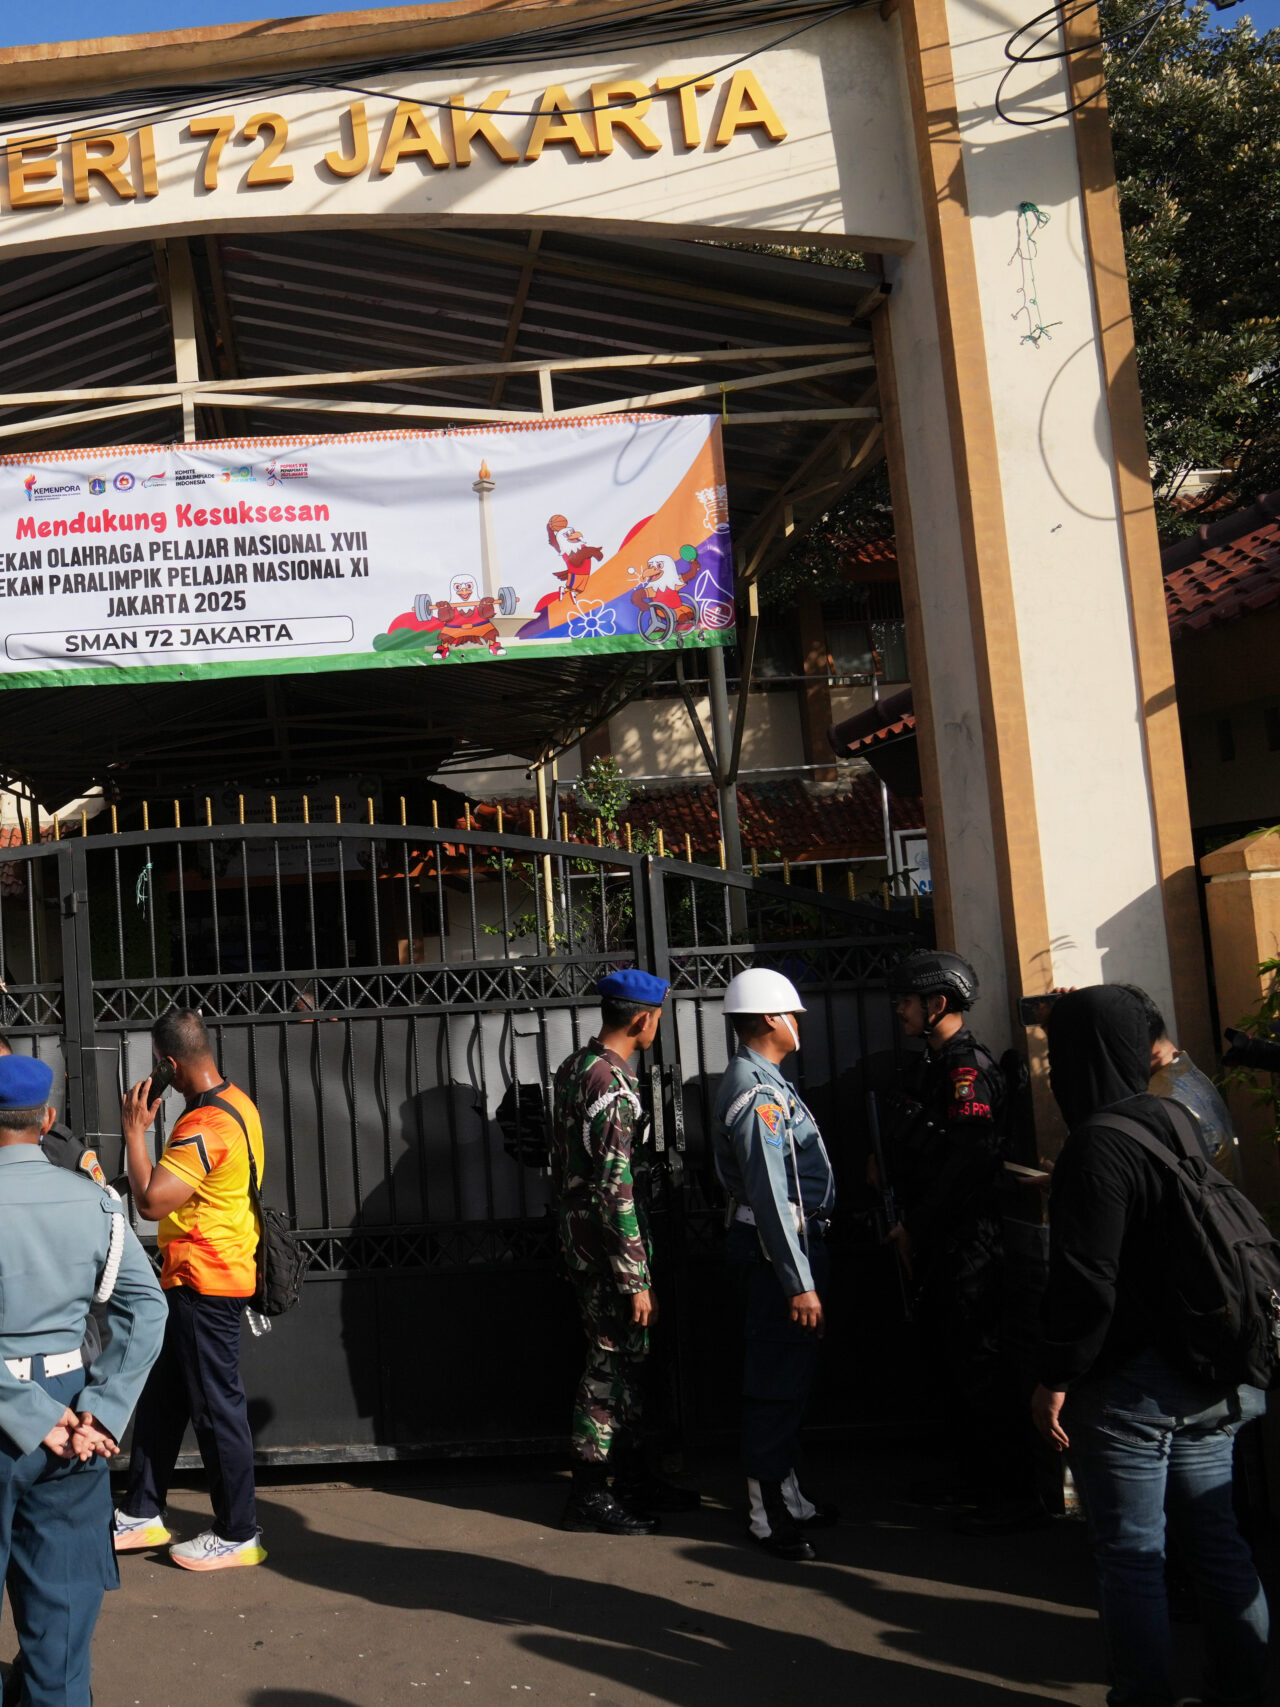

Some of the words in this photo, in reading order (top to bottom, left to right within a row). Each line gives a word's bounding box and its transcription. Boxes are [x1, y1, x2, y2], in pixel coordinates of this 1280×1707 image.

[189, 112, 294, 191] 72
[323, 69, 788, 178] JAKARTA
[33, 485, 80, 494] KEMENPORA
[16, 509, 167, 540] Mendukung
[176, 501, 330, 529] Kesuksesan
[47, 543, 144, 568] OLAHRAGA
[149, 538, 229, 561] PELAJAR
[234, 533, 326, 557] NASIONAL
[331, 531, 368, 552] XVII
[49, 568, 163, 593] PARALIMPIK
[167, 563, 248, 588] PELAJAR
[253, 559, 345, 582] NASIONAL
[350, 556, 369, 578] XI
[107, 594, 189, 617] JAKARTA
[194, 590, 247, 613] 2025
[65, 629, 138, 653] SMAN
[144, 628, 174, 649] 72
[180, 624, 293, 645] JAKARTA
